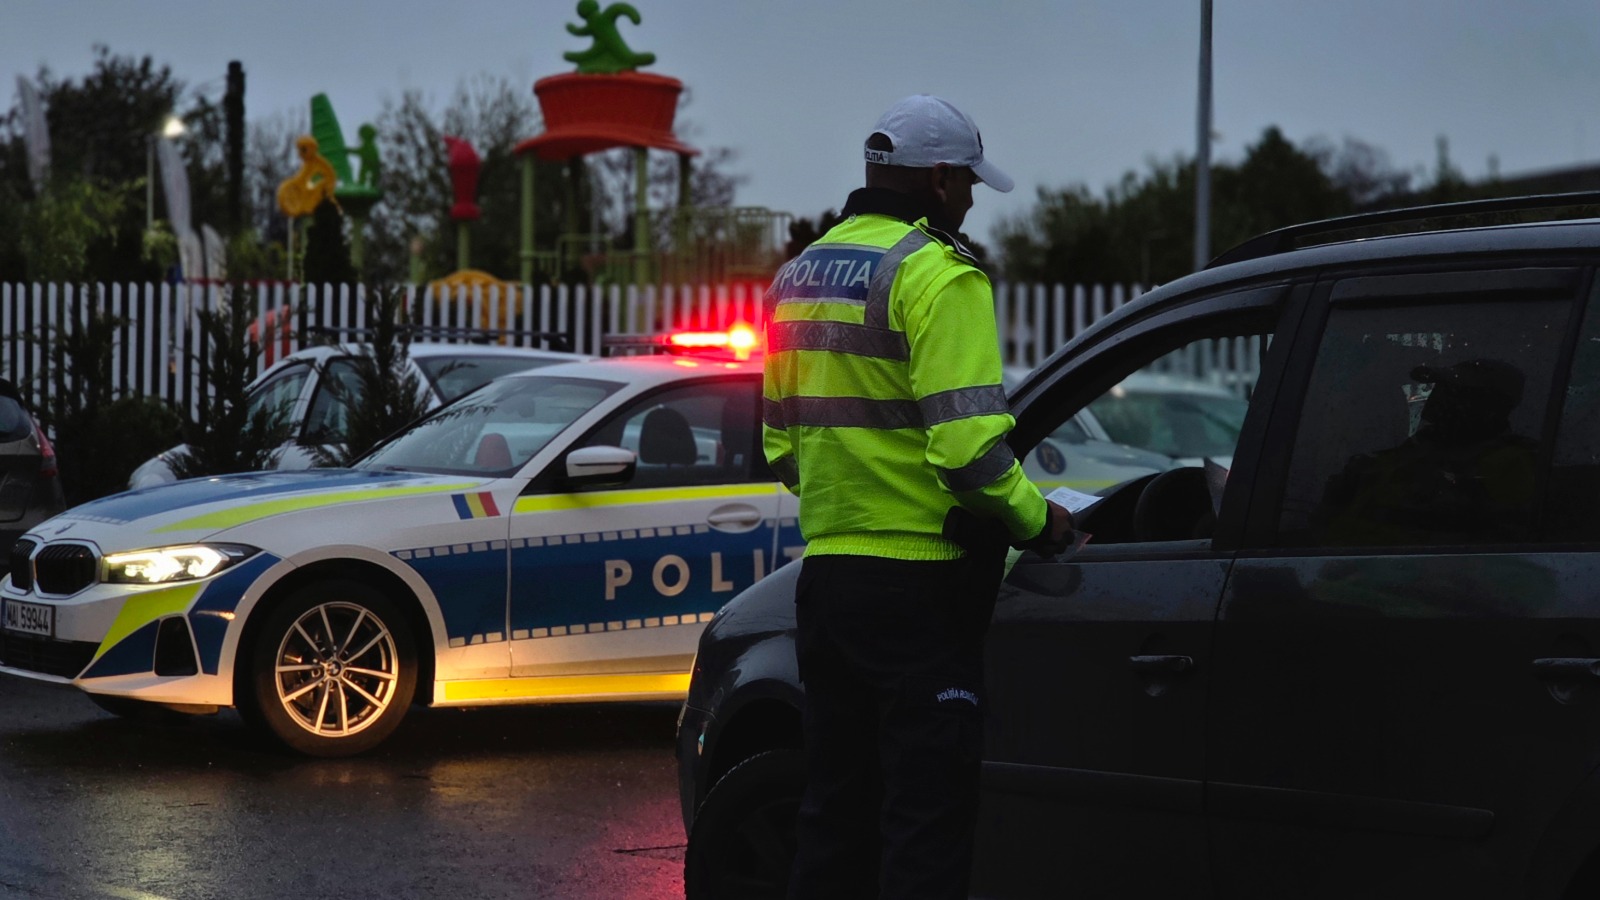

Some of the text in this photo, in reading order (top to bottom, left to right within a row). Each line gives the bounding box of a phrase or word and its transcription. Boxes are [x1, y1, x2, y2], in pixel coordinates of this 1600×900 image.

[865, 150, 884, 162] OLITIA
[779, 259, 872, 290] POLITIA
[7, 603, 48, 632] MAI 59944
